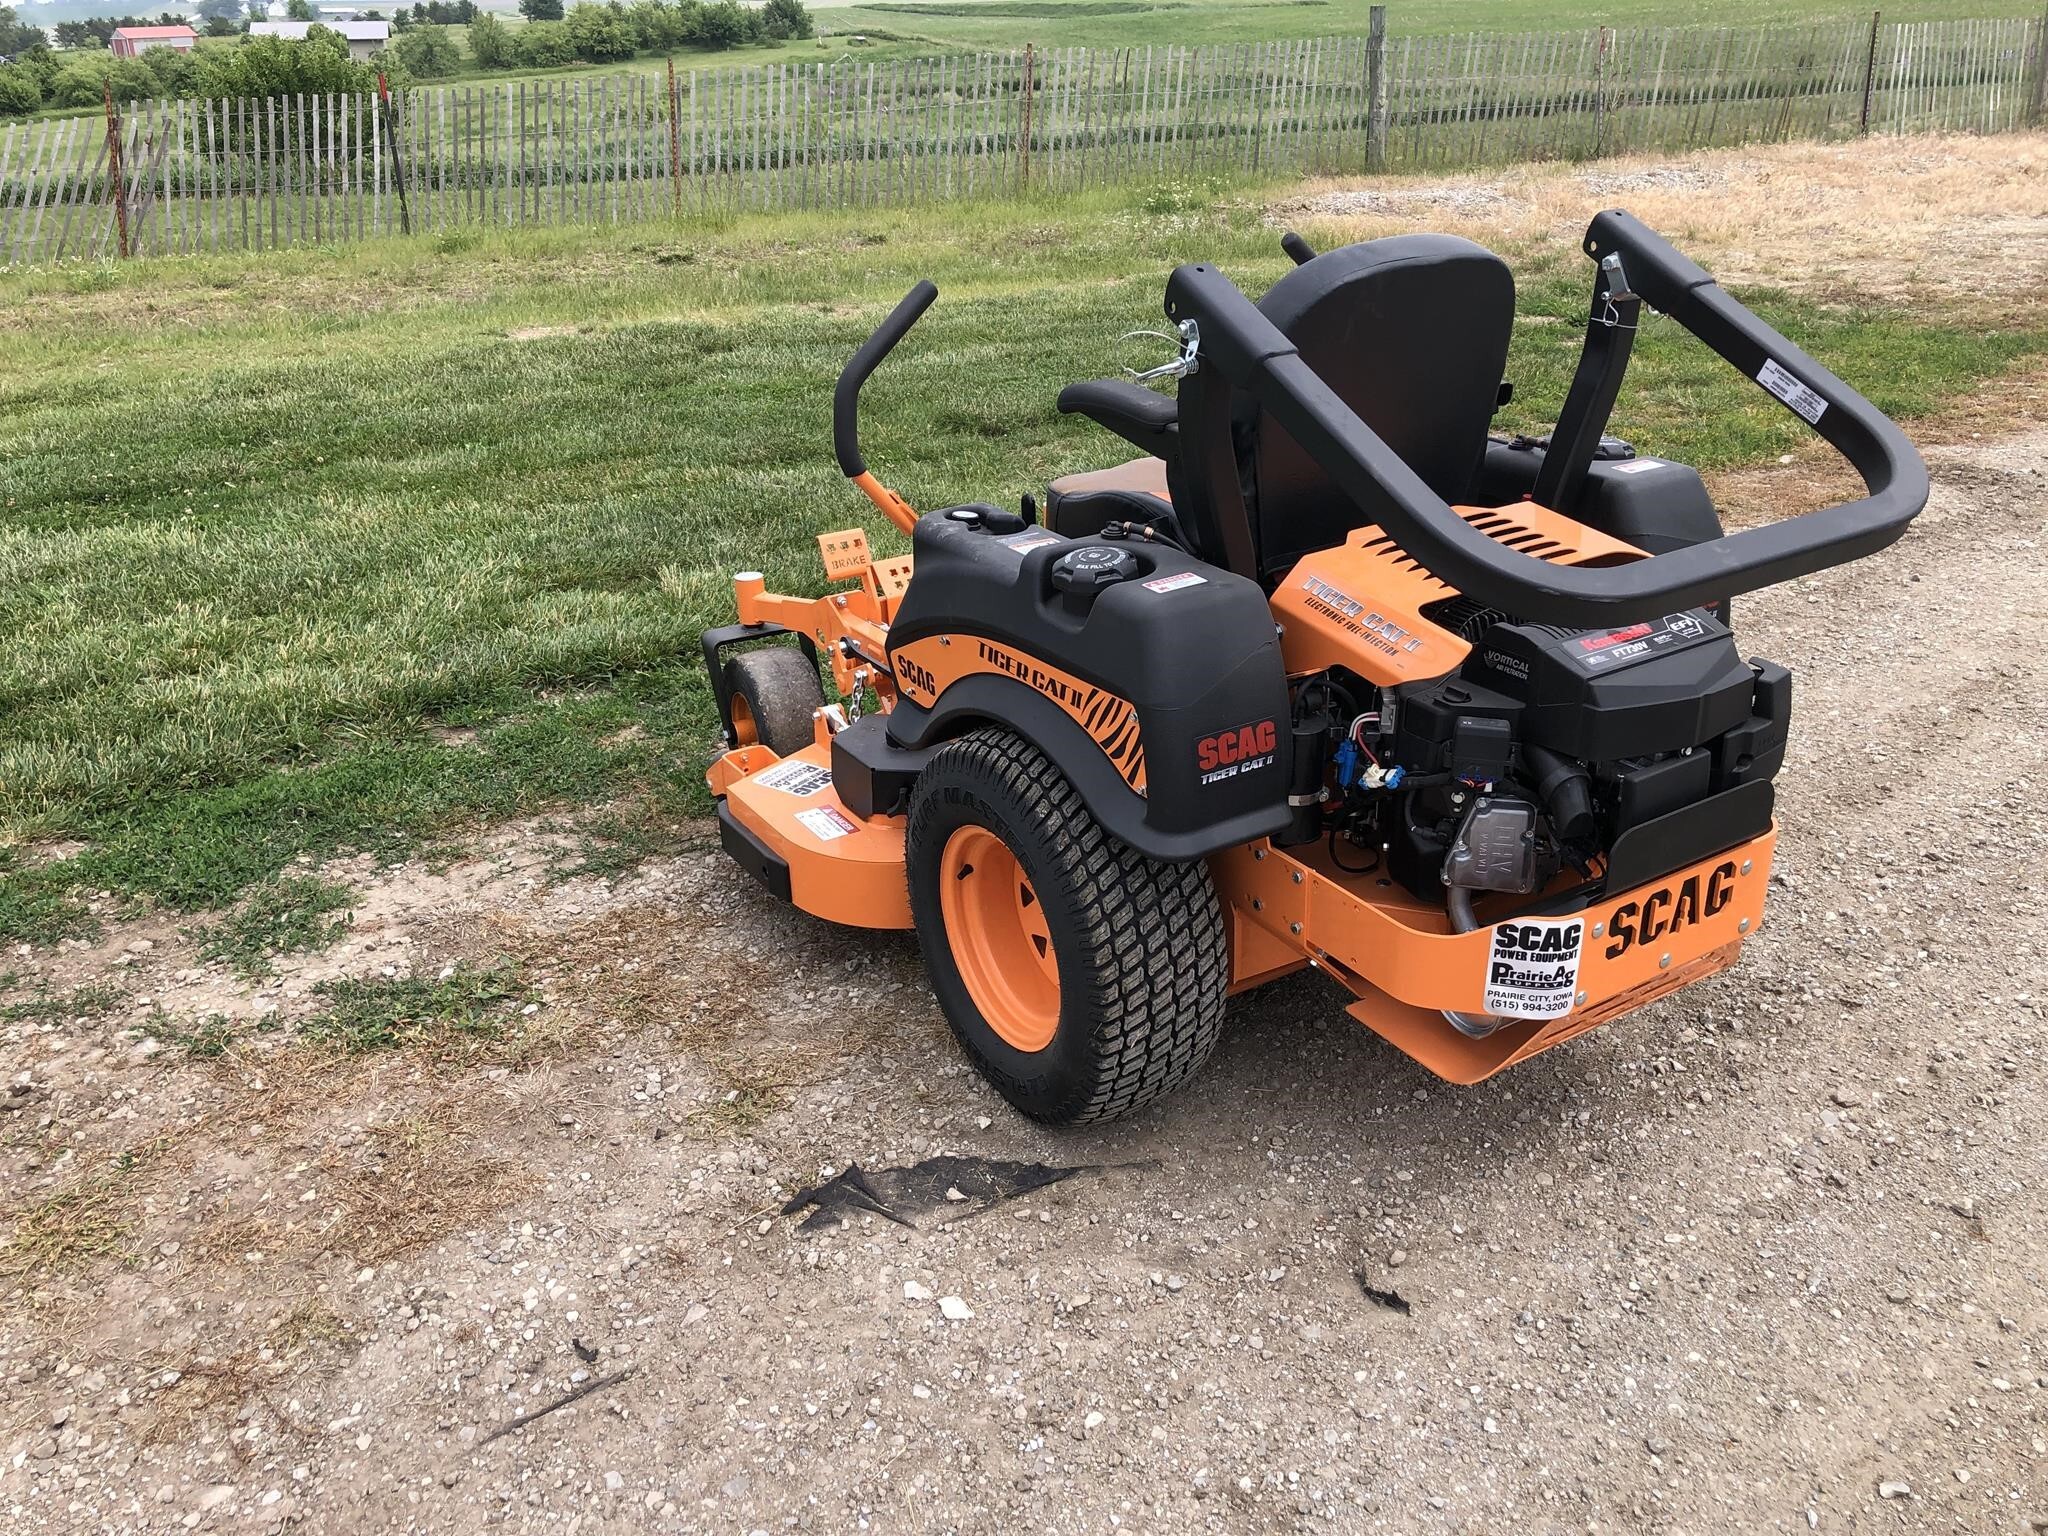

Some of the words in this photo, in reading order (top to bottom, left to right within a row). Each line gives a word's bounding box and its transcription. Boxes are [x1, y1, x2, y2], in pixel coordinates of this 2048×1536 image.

[832, 555, 866, 569] BRAKE
[1302, 575, 1365, 618] TIGER
[1361, 612, 1410, 643] CAT
[1304, 597, 1346, 625] ELECTRONIC
[1488, 650, 1529, 672] VORTICAL
[1611, 641, 1648, 658] FT730V
[898, 654, 936, 697] SCAG
[976, 639, 1029, 683] TIGER
[1032, 669, 1071, 702] CAT
[1069, 690, 1083, 710] II
[1198, 720, 1275, 770] SCAG
[1201, 765, 1238, 785] TIGER
[1241, 757, 1265, 773] CAT
[1605, 861, 1737, 960] SCAG
[1495, 924, 1581, 952] SCAG
[1494, 949, 1527, 961] POWER
[1530, 949, 1578, 963] EQUIPMENT
[1487, 990, 1526, 1000] PRAIRIE
[1528, 994, 1551, 1003] CITY,
[1553, 991, 1573, 1001] IOWA
[1505, 979, 1560, 988] SUPPLY
[1491, 999, 1519, 1011] (515)
[1522, 1000, 1568, 1011] 994-3200
